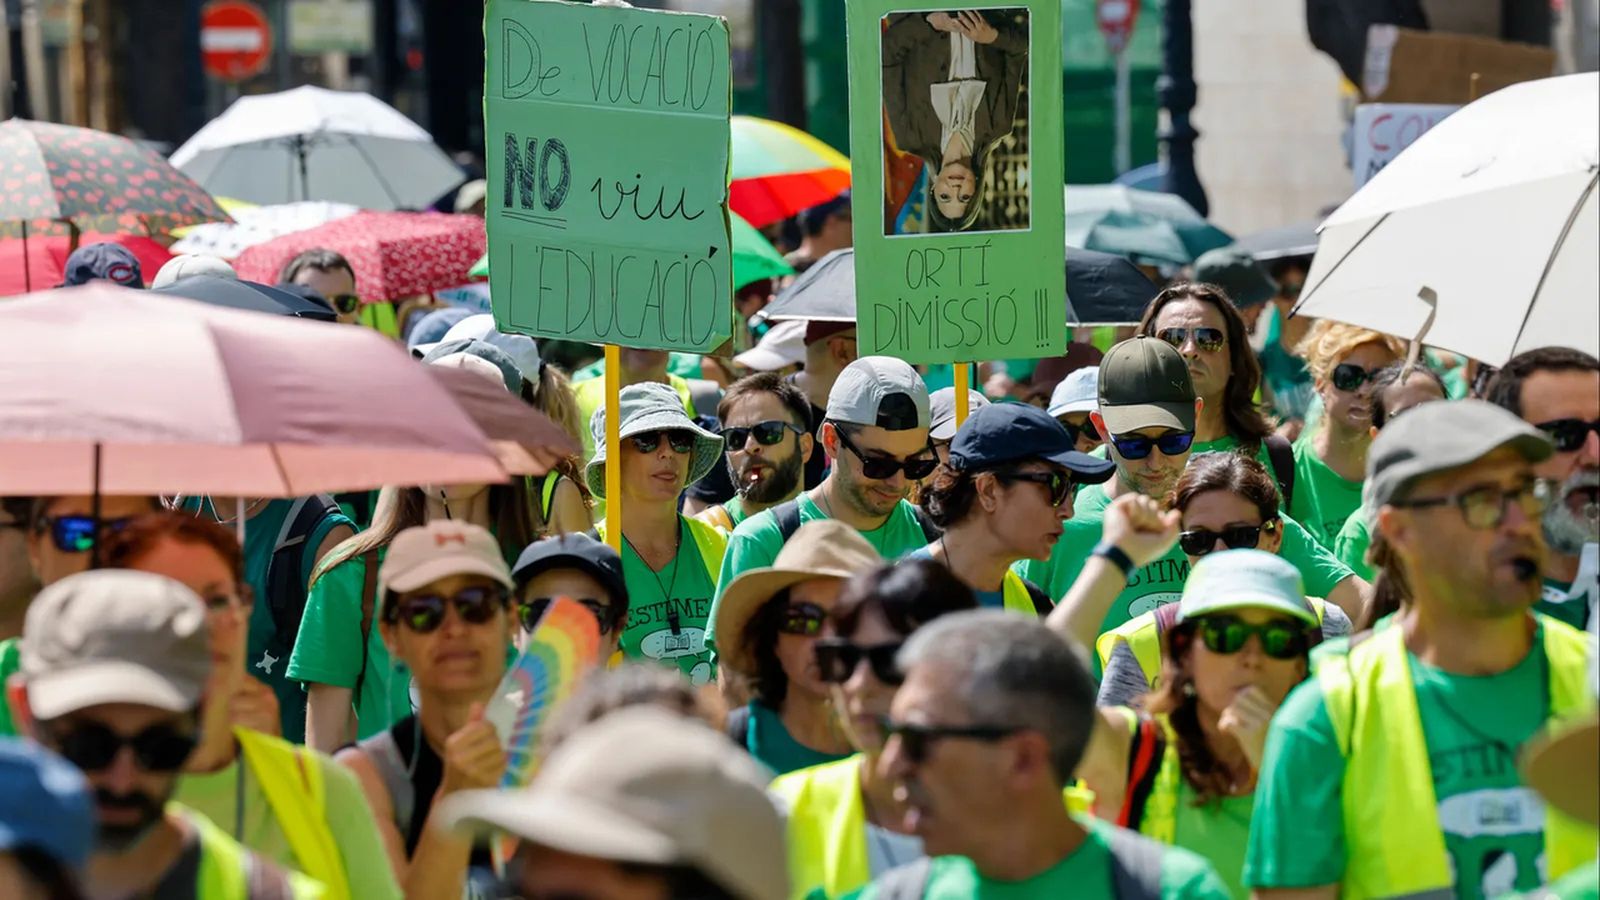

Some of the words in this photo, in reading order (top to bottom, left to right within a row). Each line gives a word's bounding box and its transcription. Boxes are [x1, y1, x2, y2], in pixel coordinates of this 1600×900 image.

[502, 18, 561, 99] De
[503, 131, 571, 212] NO
[590, 173, 704, 220] viu
[509, 243, 718, 346] L'EDUCACIÓ
[905, 238, 992, 290] ORTÍ
[873, 288, 1018, 353] DIMISSIÓ
